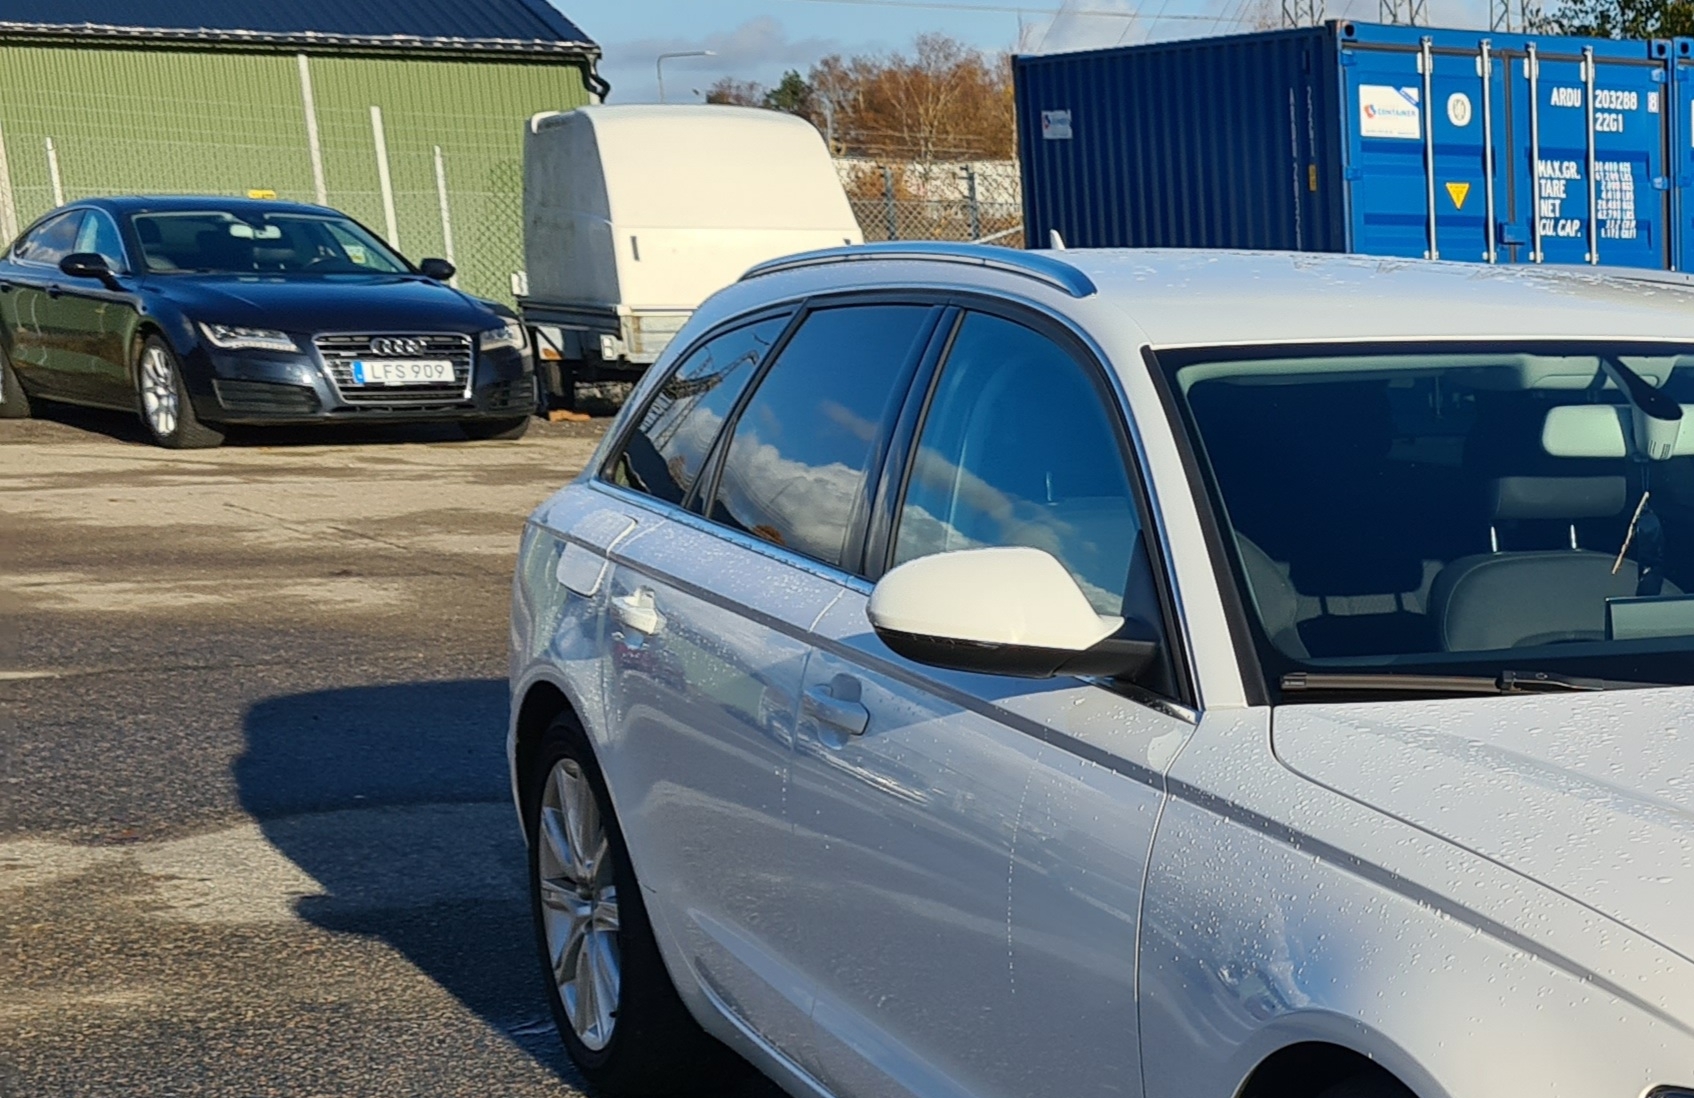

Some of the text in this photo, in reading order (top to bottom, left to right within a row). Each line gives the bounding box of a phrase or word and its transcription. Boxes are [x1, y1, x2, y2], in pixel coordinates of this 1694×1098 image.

[1550, 87, 1581, 107] ARDU
[1595, 89, 1638, 110] 203288
[1595, 112, 1624, 133] 22G1
[1540, 179, 1567, 198] TARE
[1540, 199, 1561, 217] NET
[371, 364, 444, 379] LFS 909
